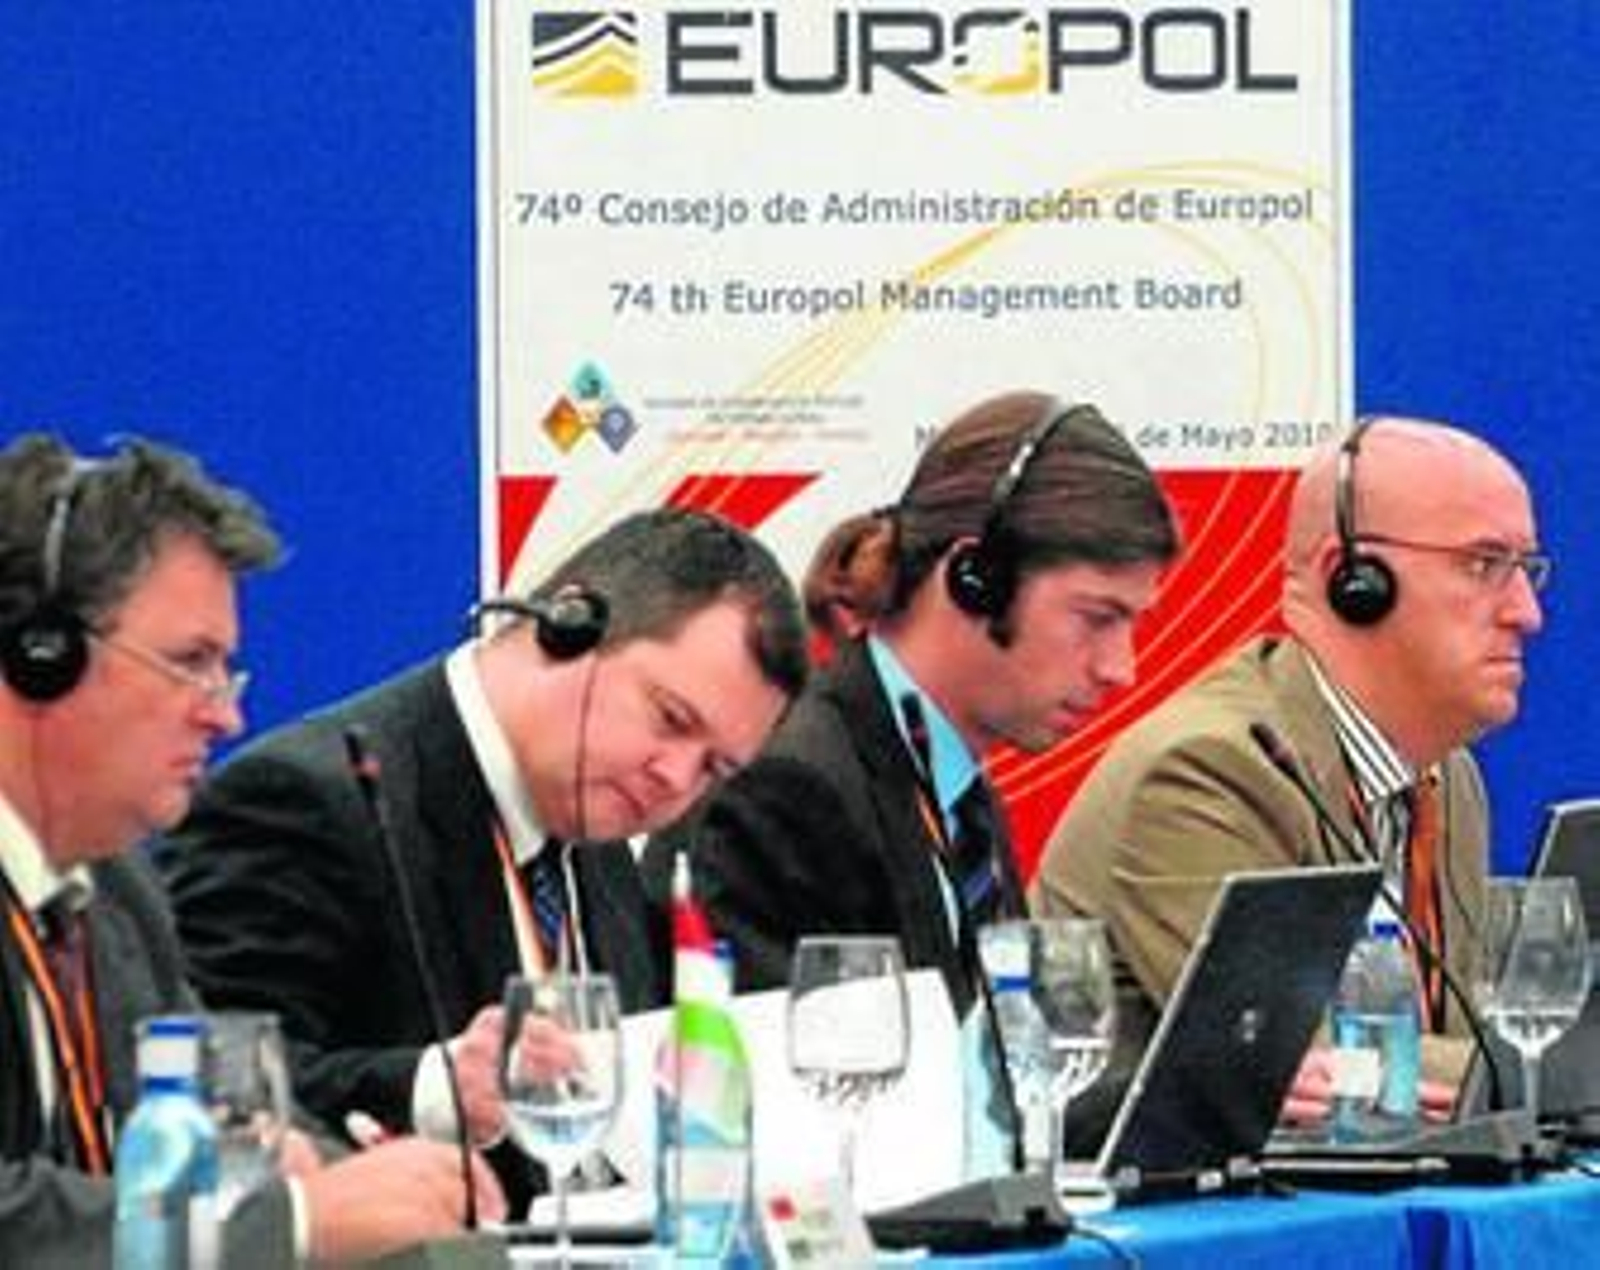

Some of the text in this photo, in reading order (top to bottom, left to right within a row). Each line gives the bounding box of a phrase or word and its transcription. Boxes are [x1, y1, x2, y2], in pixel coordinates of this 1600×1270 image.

[666, 8, 1298, 96] EUROPOL
[598, 191, 749, 230] Consejo
[763, 190, 806, 224] de
[822, 187, 1099, 224] Administración
[1113, 190, 1157, 223] de
[1174, 188, 1313, 229] Europol
[608, 279, 1243, 319] 74 th Europol Management Board
[1136, 422, 1334, 451] de Mayo 2010
